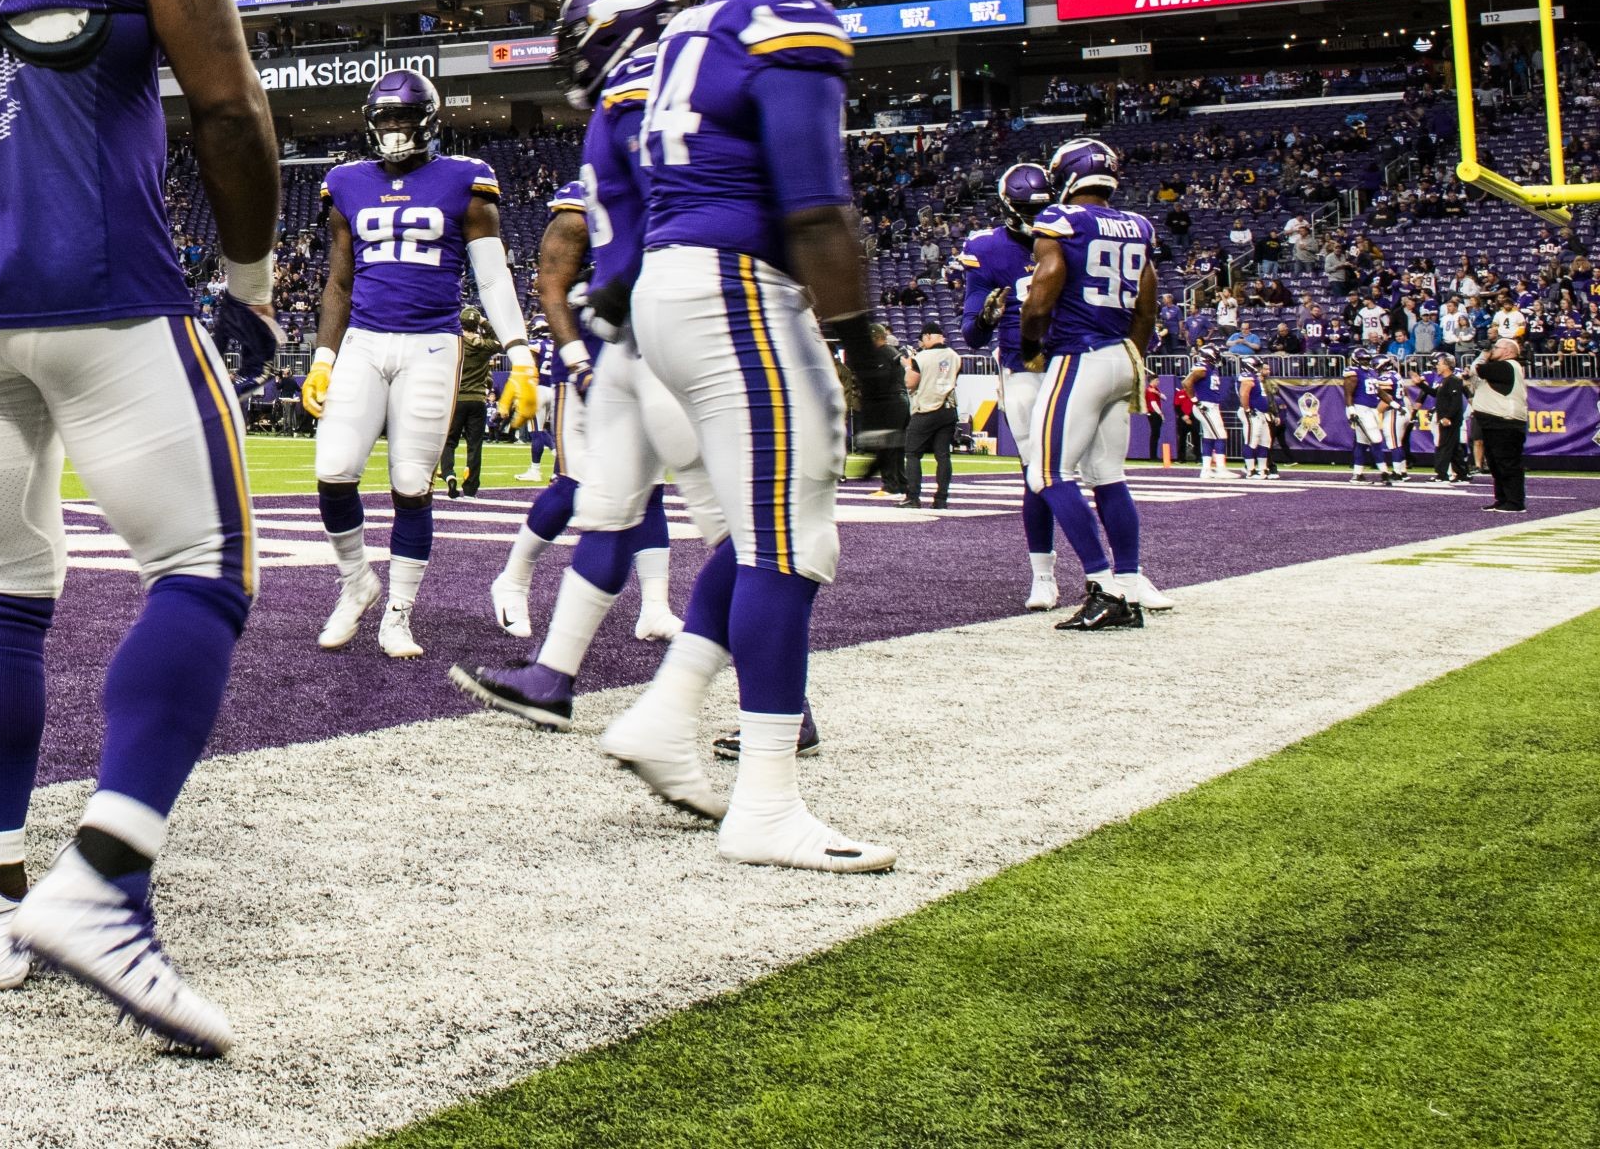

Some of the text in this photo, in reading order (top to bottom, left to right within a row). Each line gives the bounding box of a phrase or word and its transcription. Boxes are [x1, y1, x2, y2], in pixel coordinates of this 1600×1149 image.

[969, 1, 1001, 12] BEST
[900, 7, 930, 19] BEST
[972, 10, 996, 22] BUY
[1484, 12, 1500, 23] 112
[903, 17, 925, 28] BUY
[513, 47, 524, 56] It's
[1088, 43, 1148, 57] 111 112
[1095, 216, 1142, 239] HUNTER
[356, 206, 444, 266] 92
[1082, 238, 1147, 310] 99
[1364, 317, 1378, 328] 56
[1503, 317, 1510, 329] 4
[1306, 323, 1322, 337] 80
[1528, 410, 1567, 433] ICE
